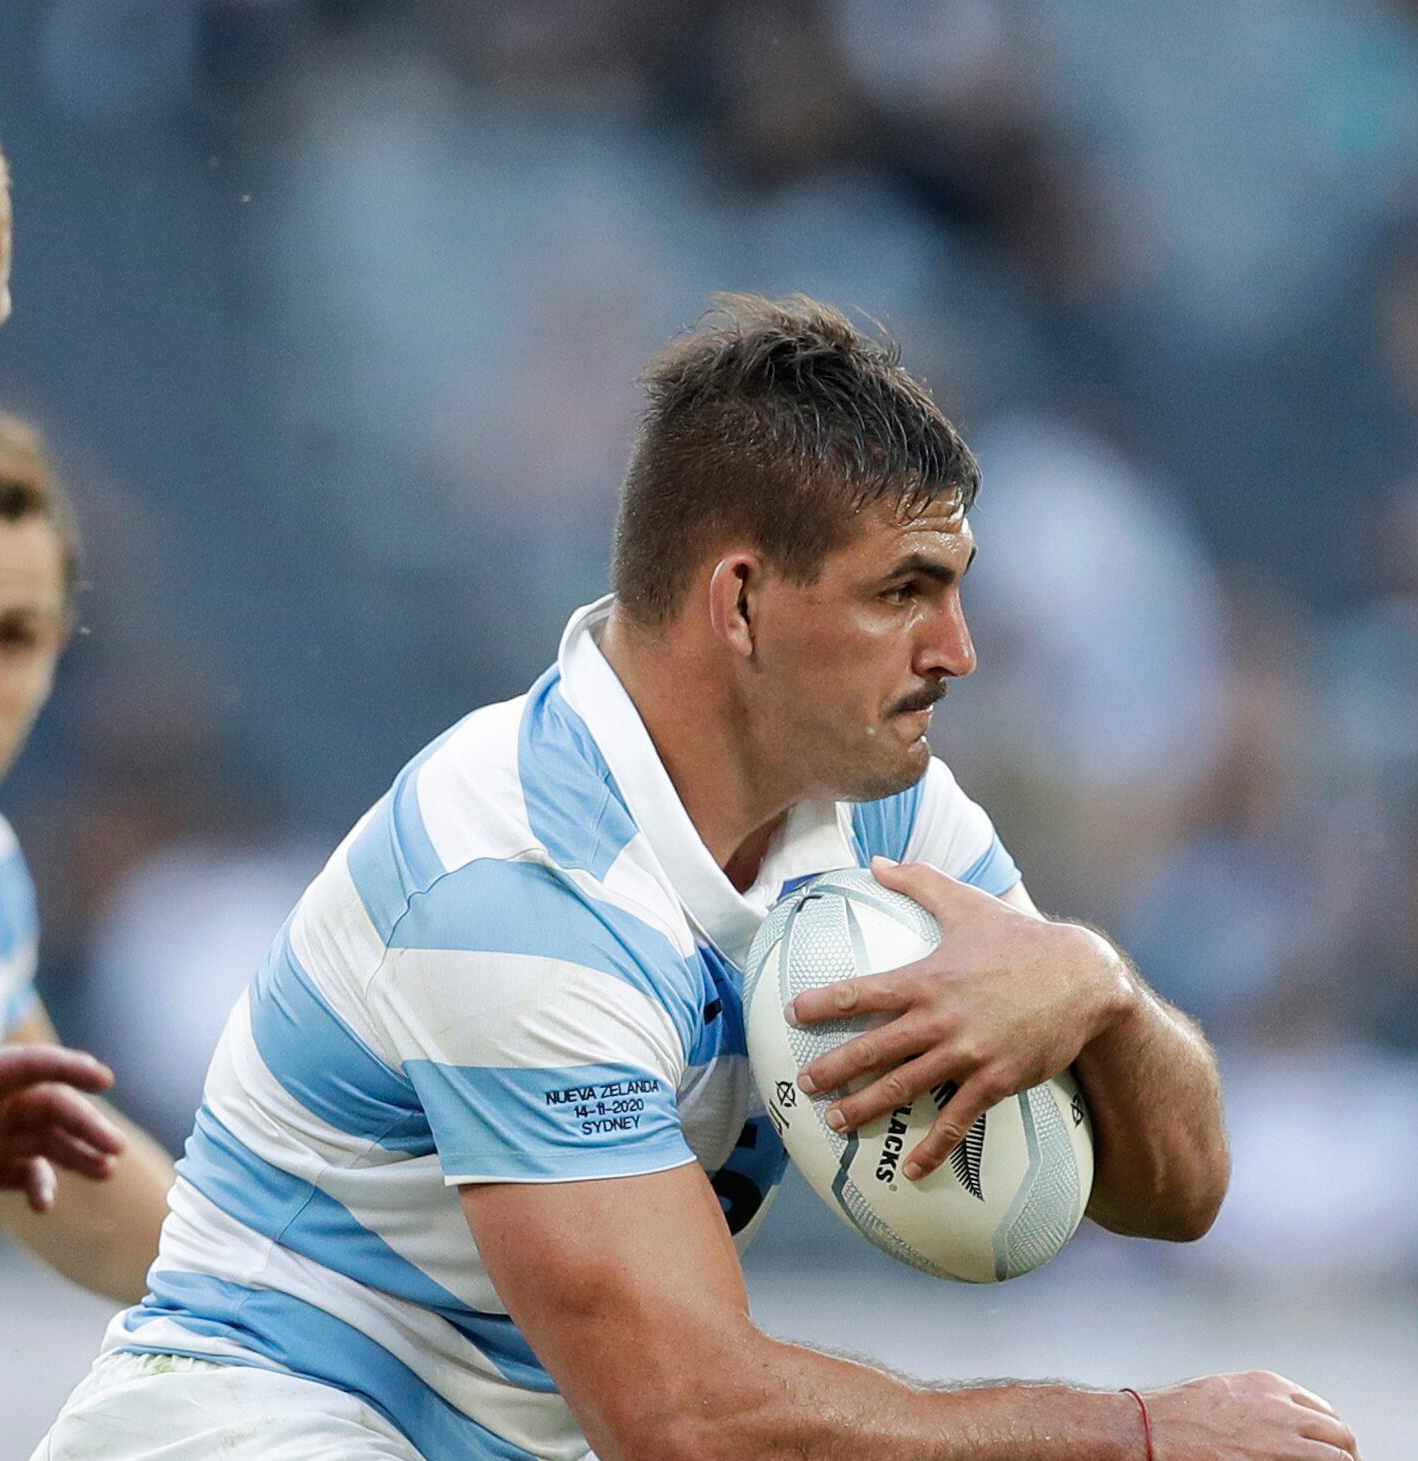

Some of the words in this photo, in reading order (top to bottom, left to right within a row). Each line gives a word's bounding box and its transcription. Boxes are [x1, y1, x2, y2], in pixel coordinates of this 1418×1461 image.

[546, 1086, 596, 1105] NUEVA
[601, 1080, 659, 1099] ZELANDA
[574, 1099, 644, 1118] 14-11-2020
[582, 1116, 641, 1135] SYDNEY
[875, 1102, 913, 1183] LACKS
